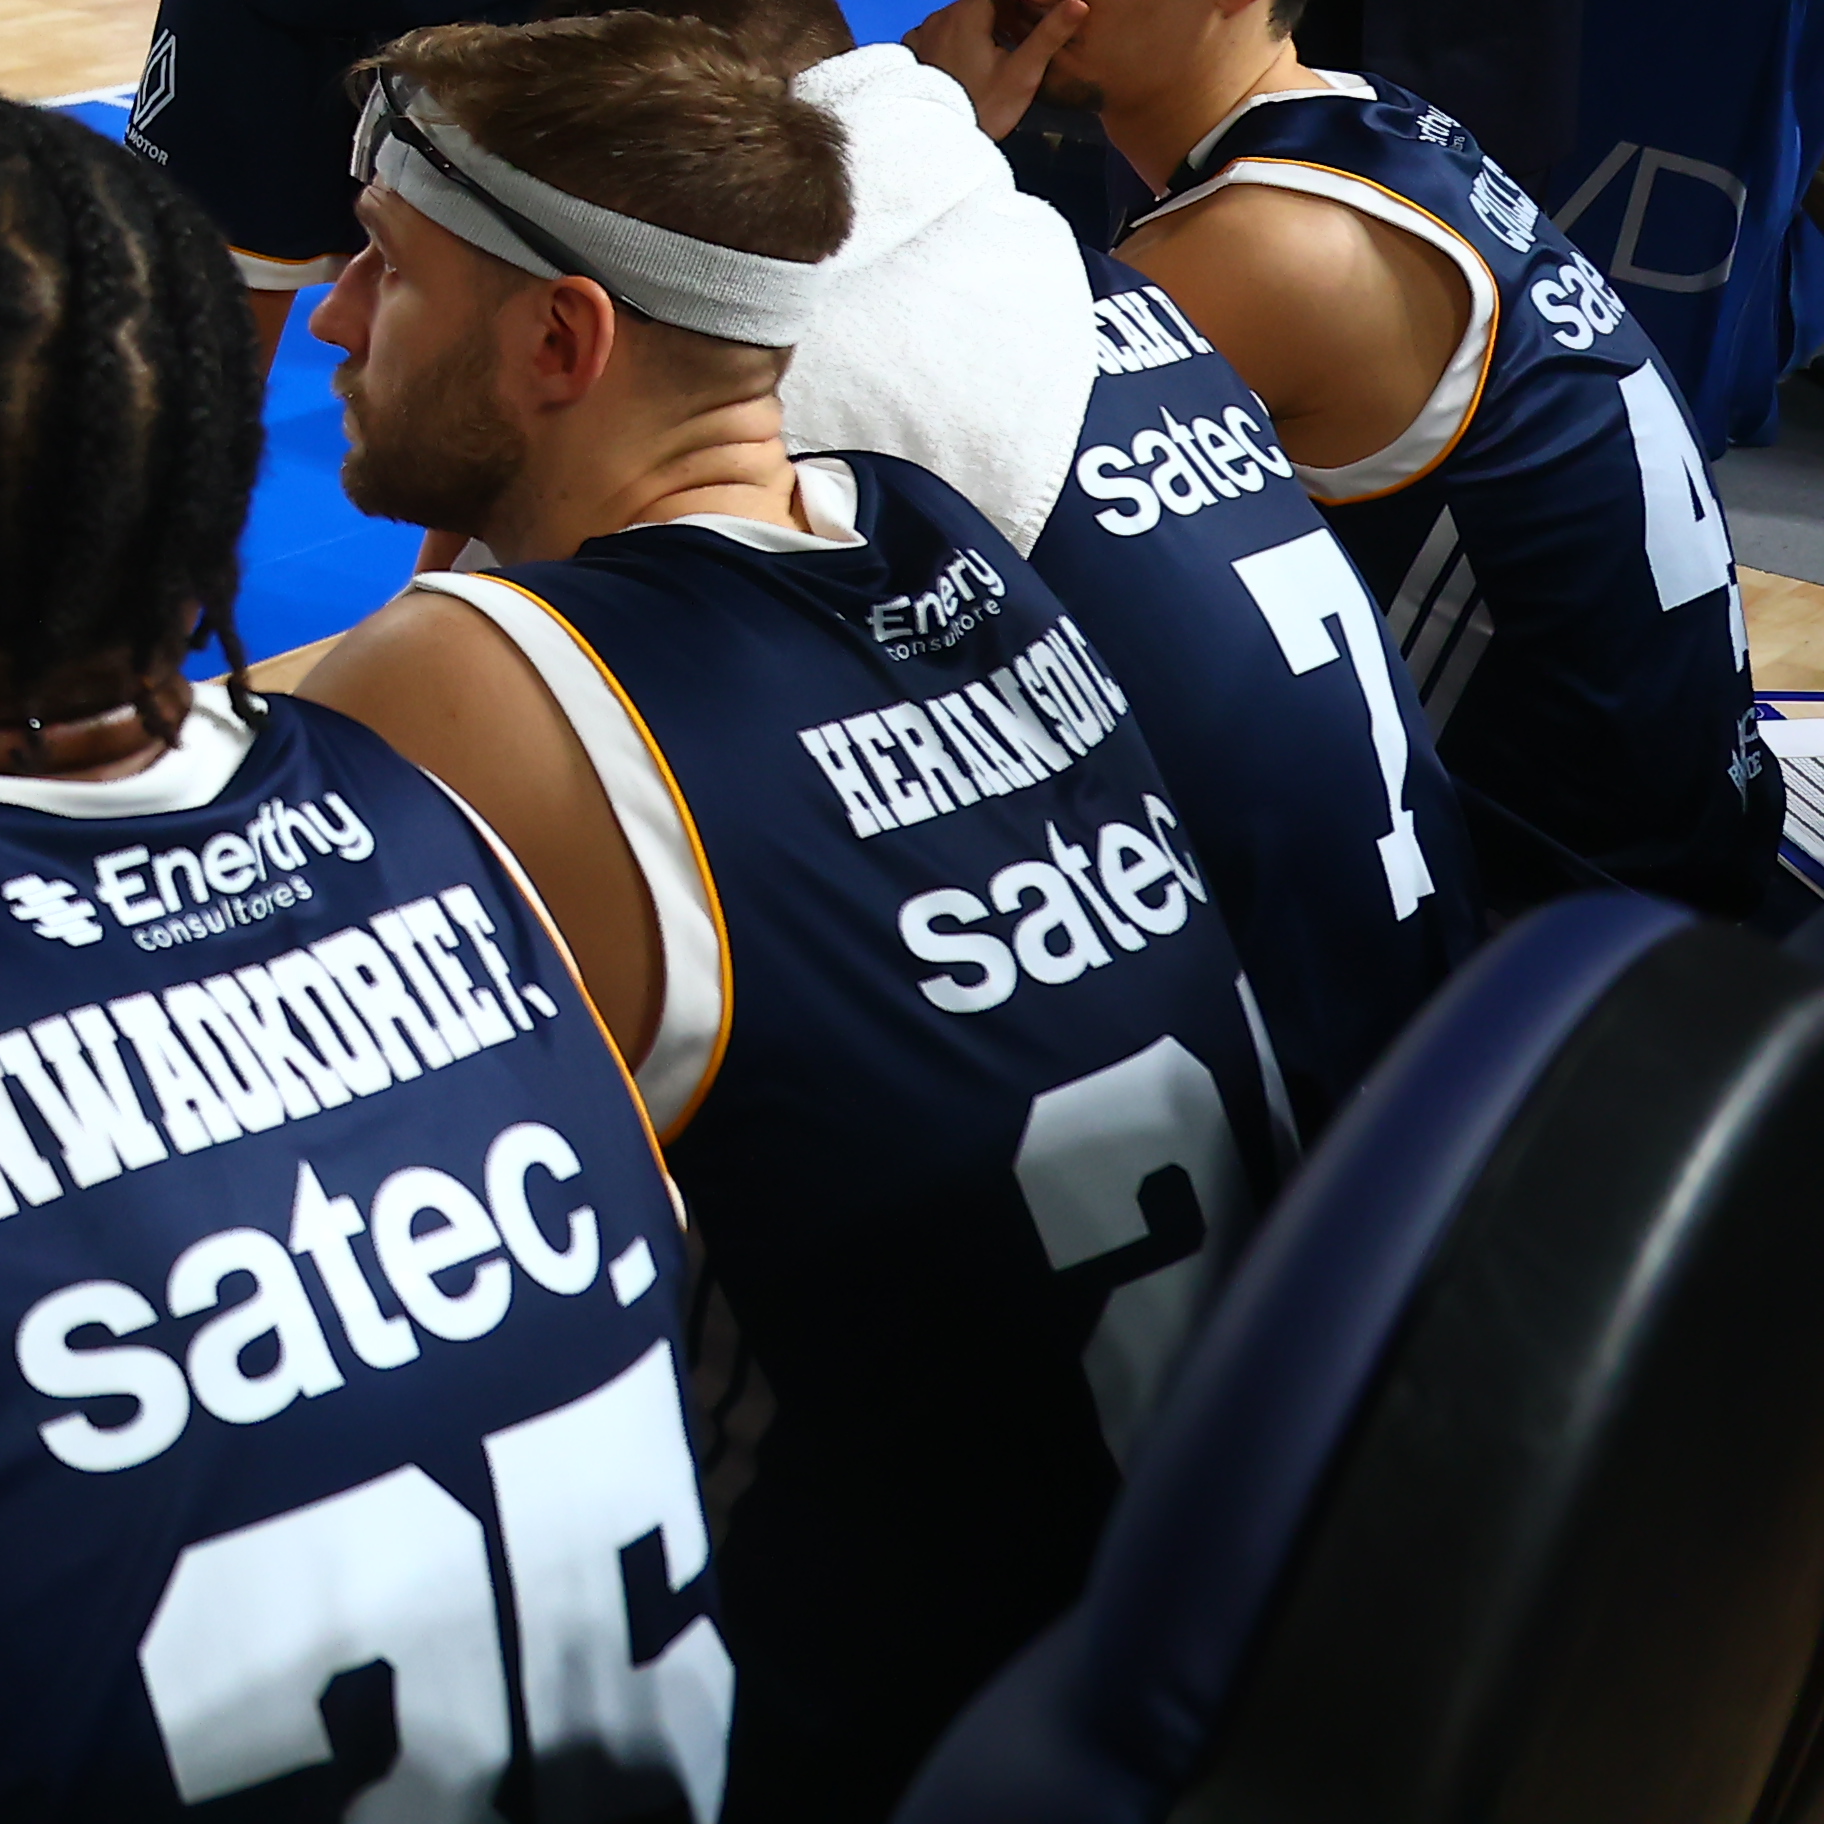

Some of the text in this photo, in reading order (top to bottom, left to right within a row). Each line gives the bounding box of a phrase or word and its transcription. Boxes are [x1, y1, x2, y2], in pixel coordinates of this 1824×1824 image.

[1231, 525, 1436, 923] 7
[93, 790, 377, 928] Enerthy
[131, 873, 315, 952] consultores
